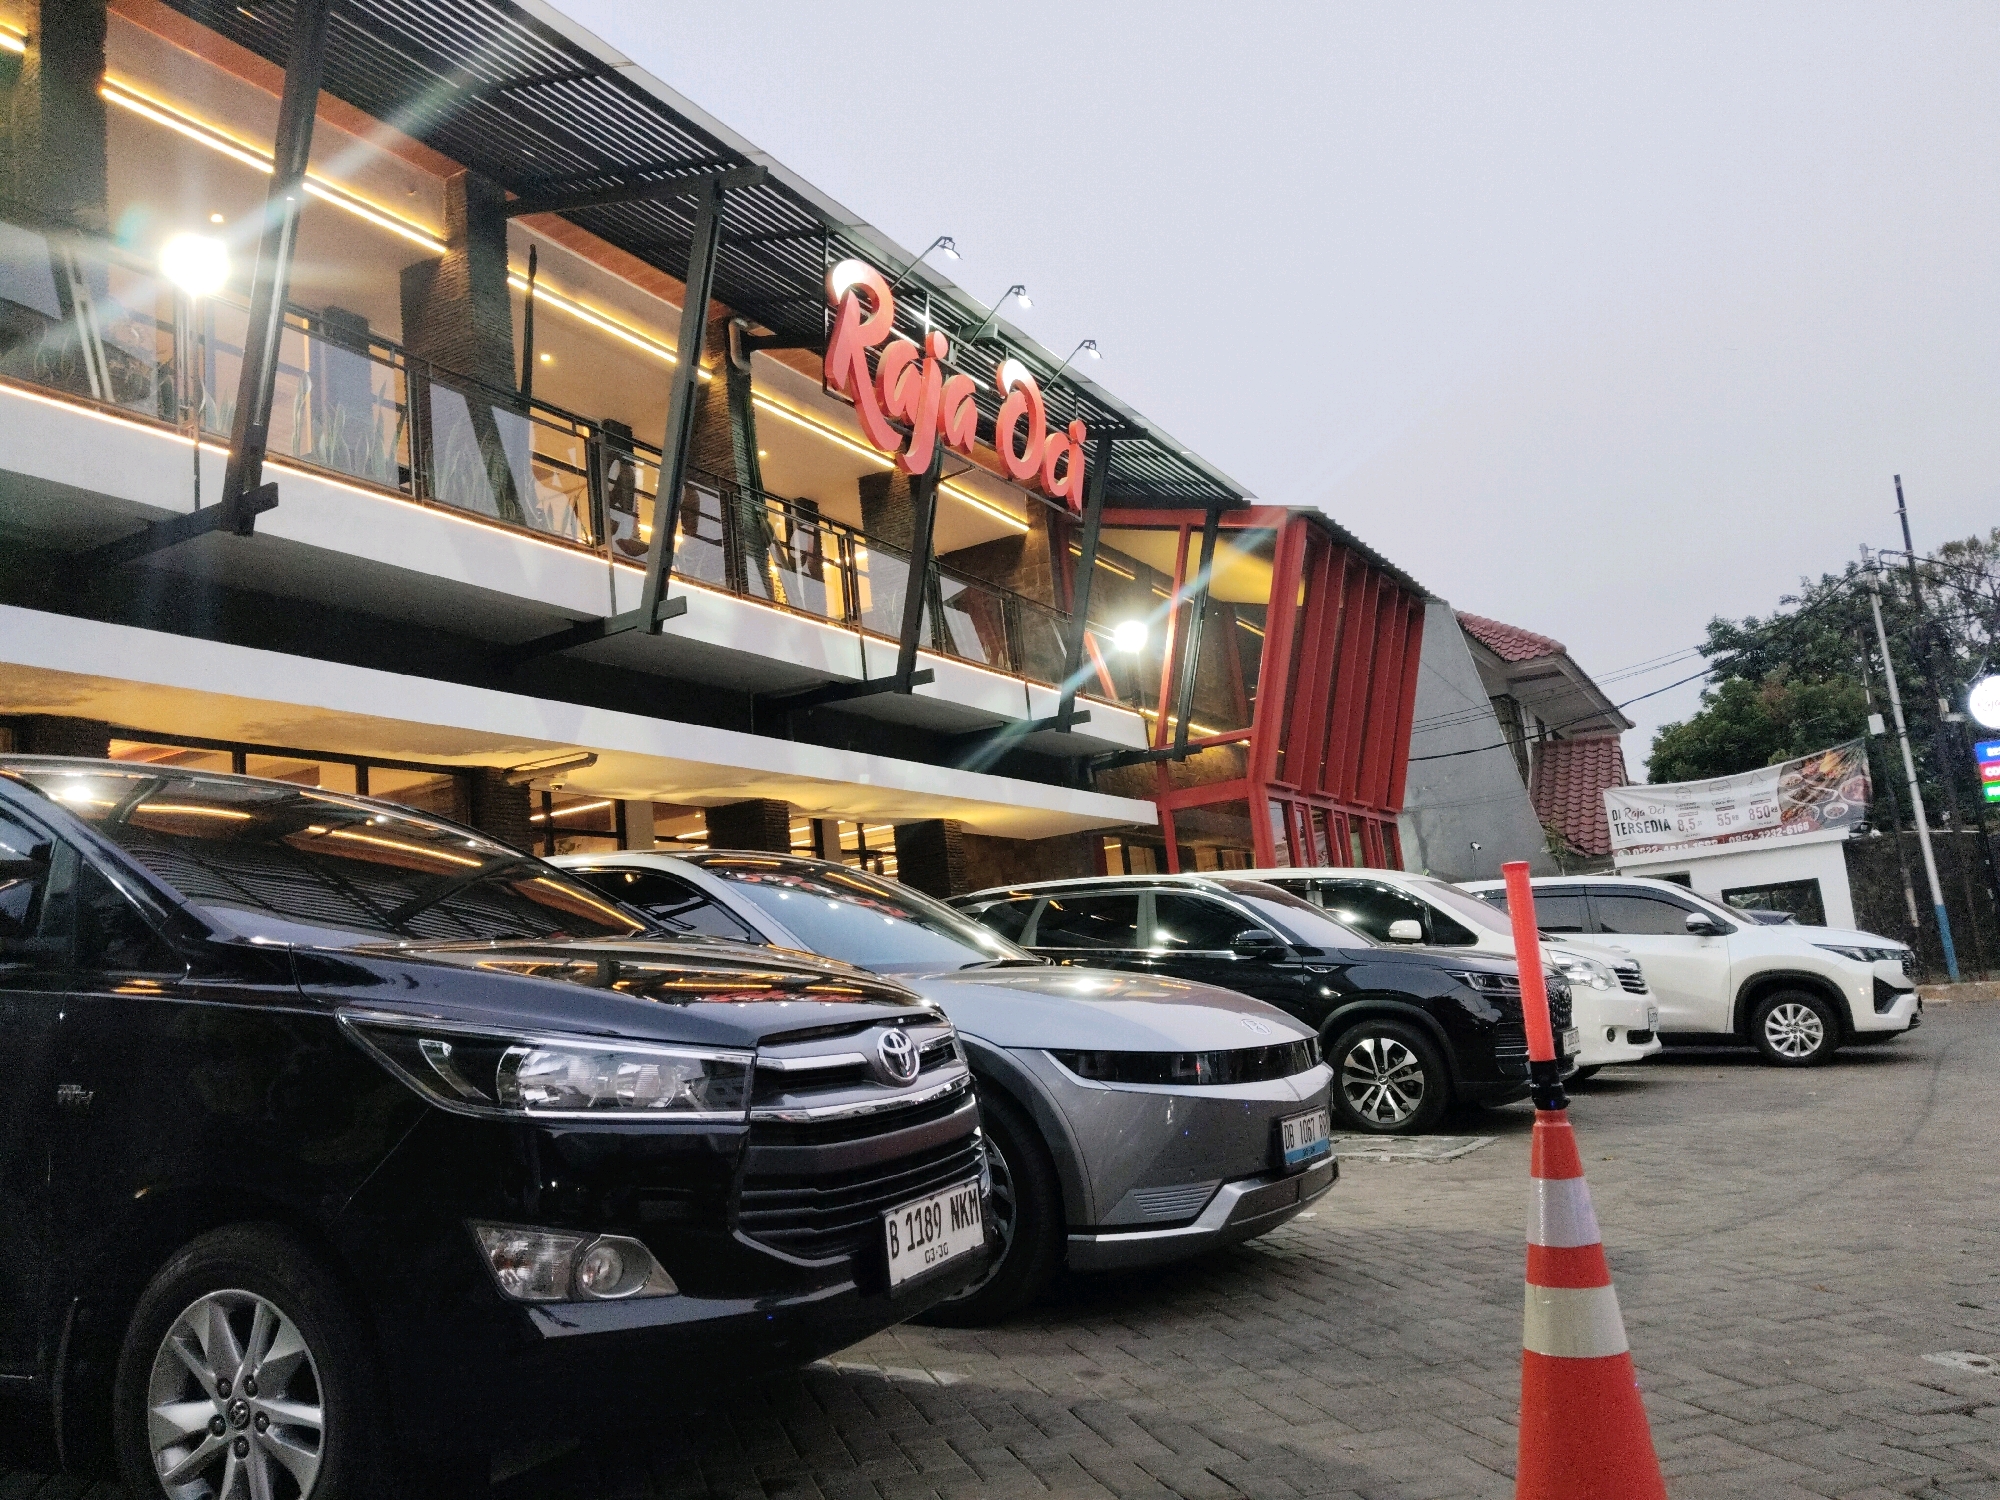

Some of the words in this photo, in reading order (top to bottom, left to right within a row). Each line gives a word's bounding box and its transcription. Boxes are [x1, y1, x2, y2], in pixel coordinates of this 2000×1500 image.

[825, 259, 978, 475] Raja
[1612, 809, 1621, 821] DI
[1624, 807, 1646, 821] Raja
[1648, 804, 1666, 815] Oci
[1613, 818, 1672, 837] TERSEDIA
[889, 1219, 900, 1260] B
[905, 1201, 942, 1252] 1189
[949, 1188, 980, 1232] NKM
